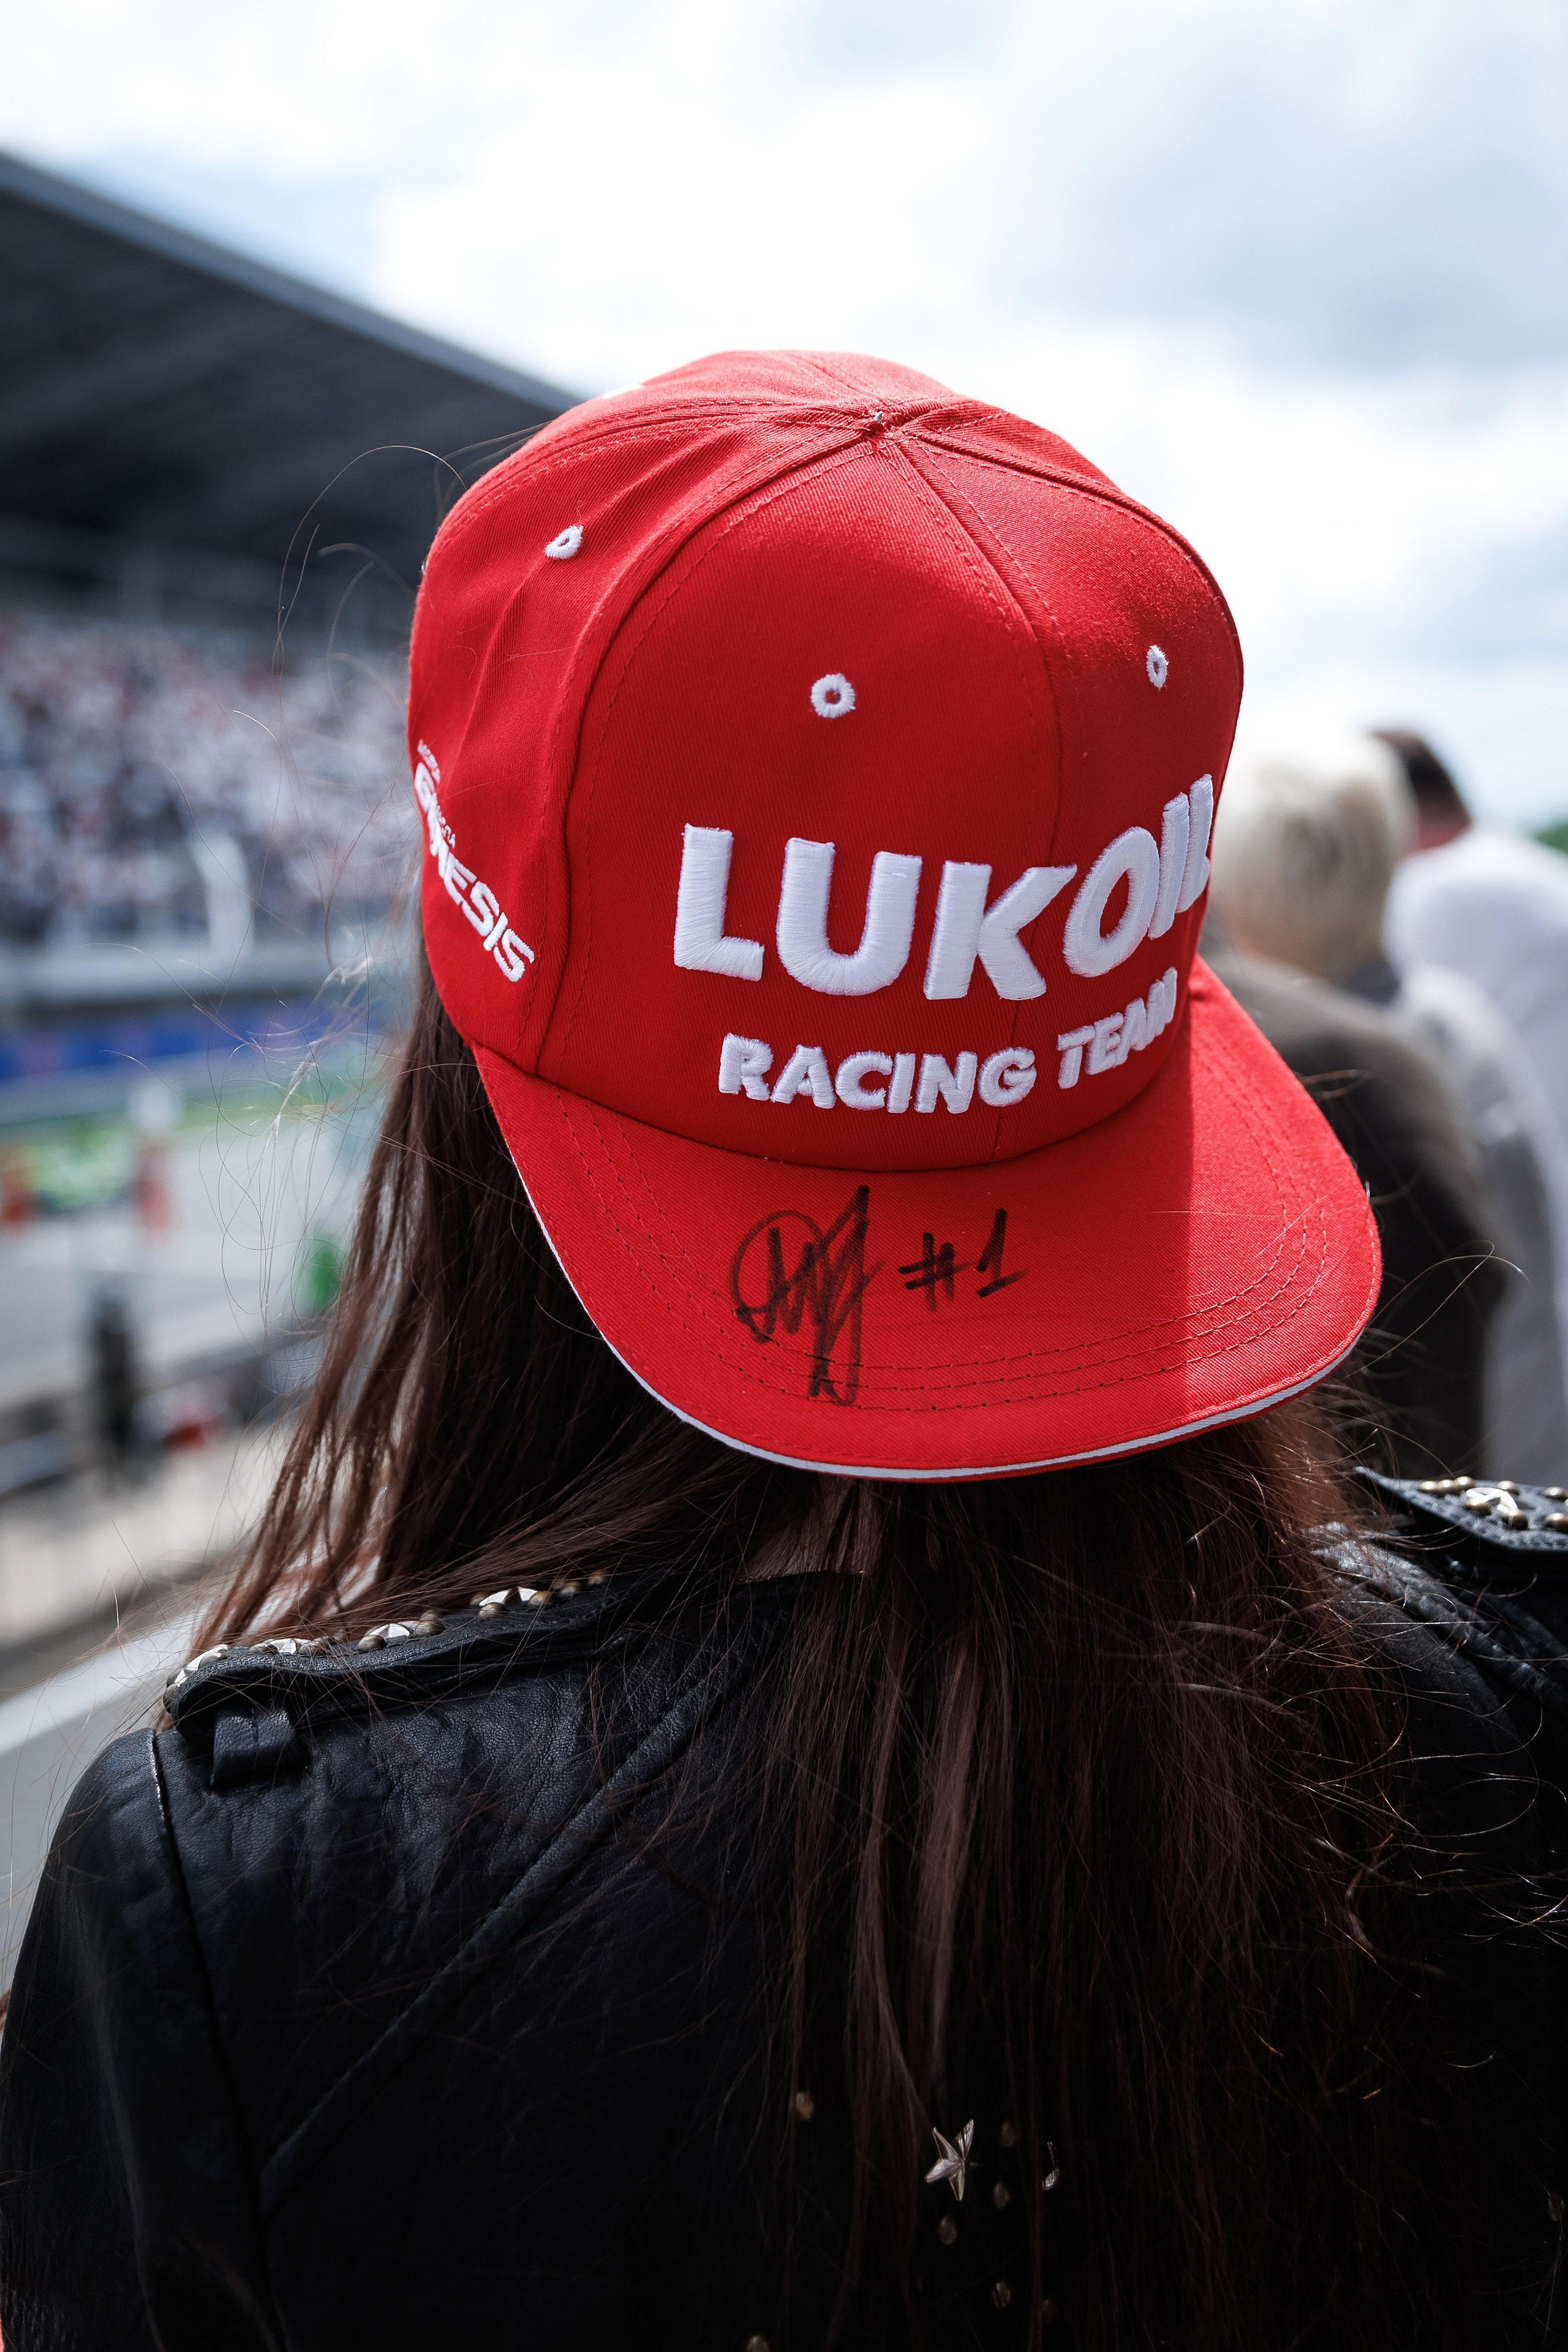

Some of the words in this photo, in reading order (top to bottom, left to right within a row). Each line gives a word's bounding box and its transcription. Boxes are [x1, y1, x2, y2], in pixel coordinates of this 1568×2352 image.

[673, 774, 1214, 1001] LUKOIL
[718, 1032, 1037, 1114] RACING
[1057, 967, 1178, 1089] TEAM
[897, 1208, 1030, 1313] #1
